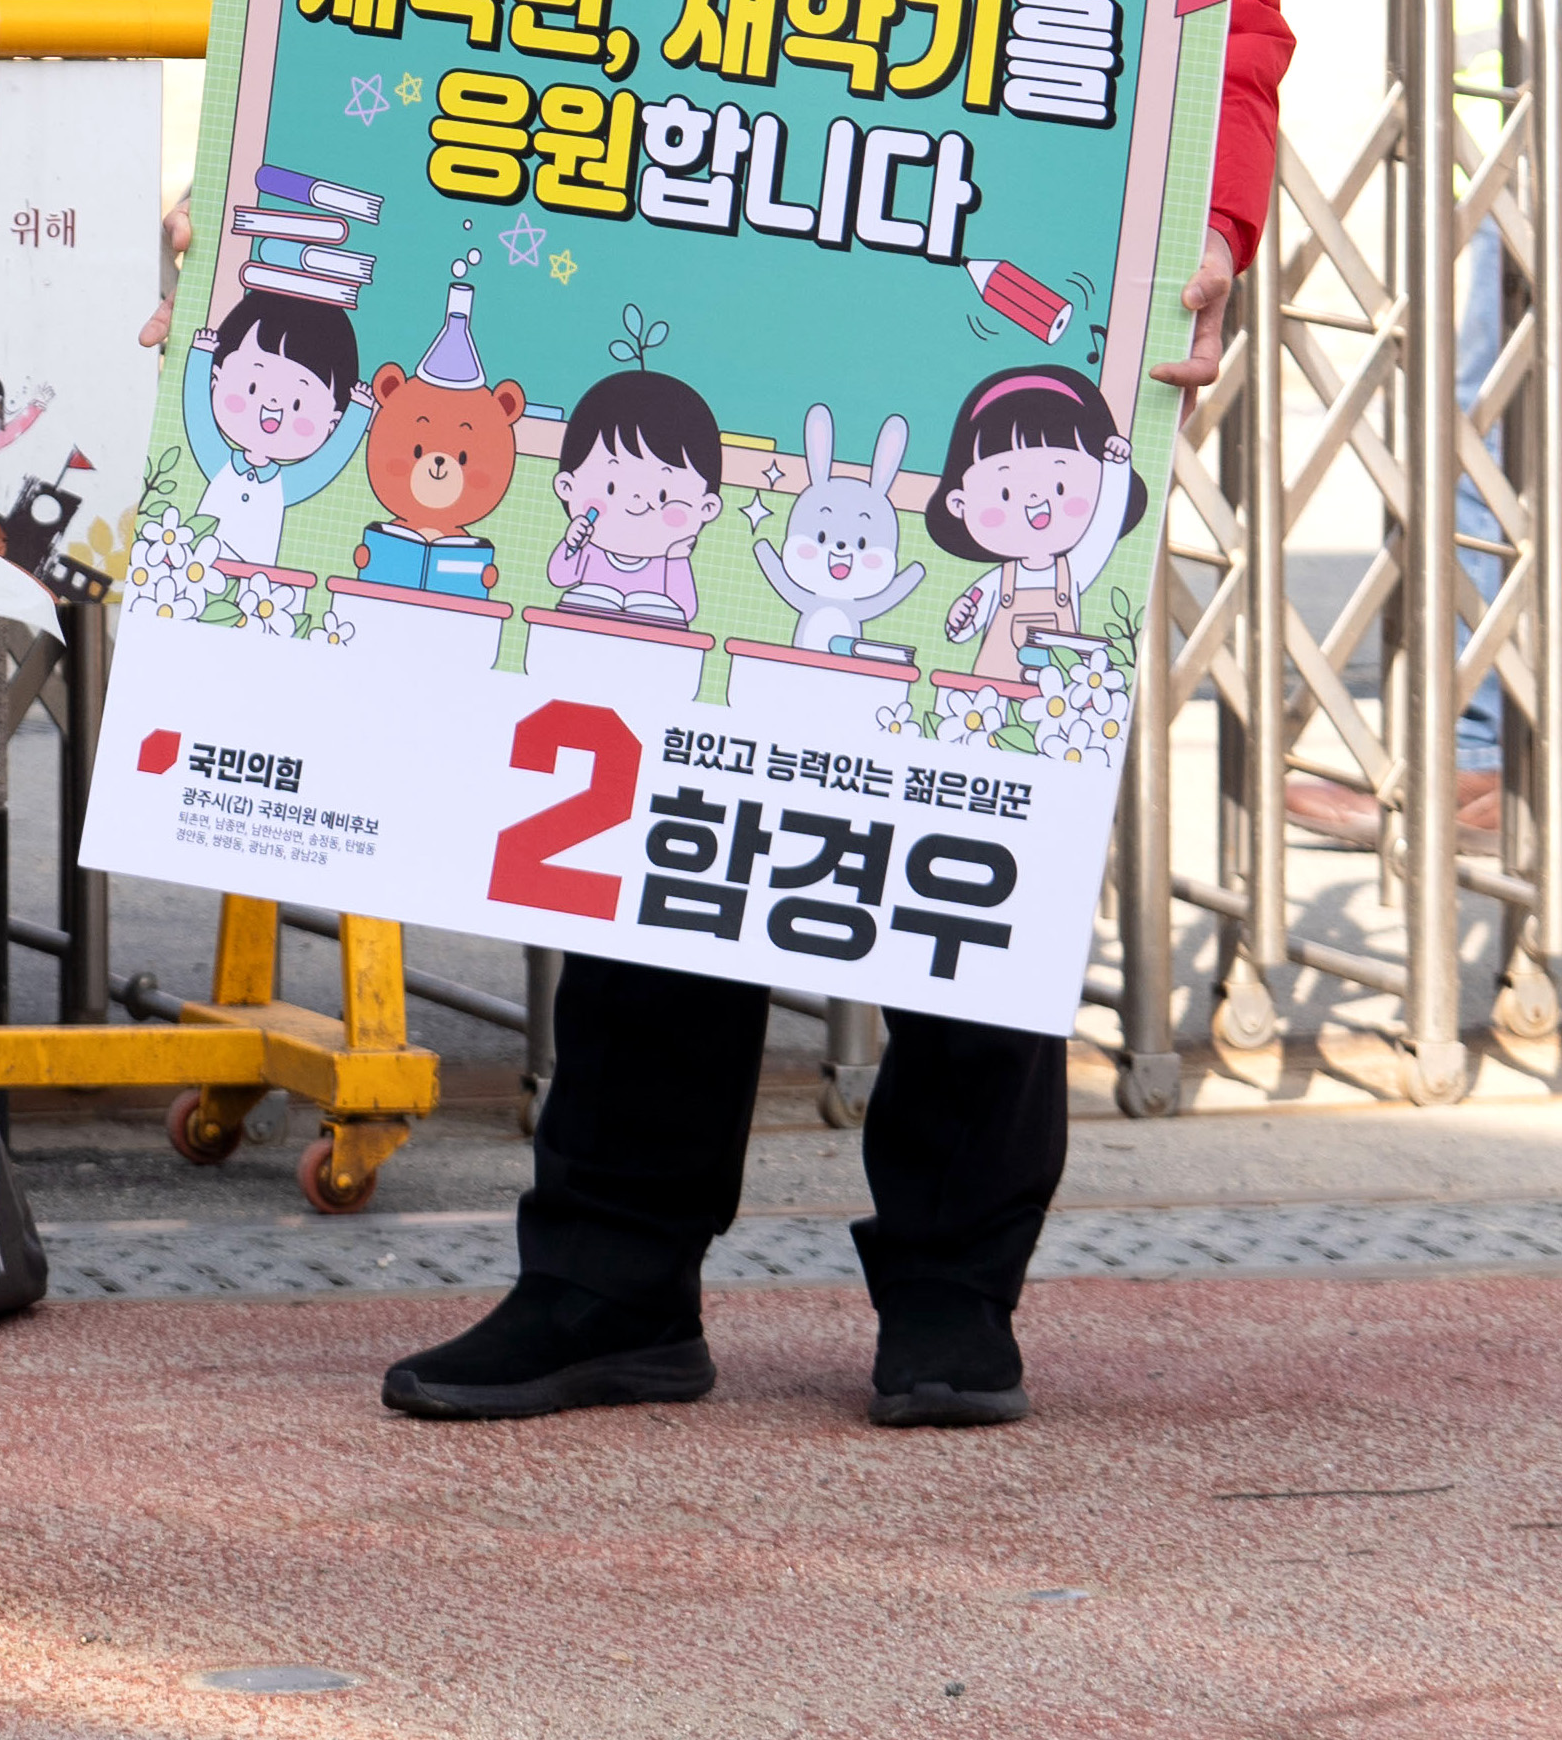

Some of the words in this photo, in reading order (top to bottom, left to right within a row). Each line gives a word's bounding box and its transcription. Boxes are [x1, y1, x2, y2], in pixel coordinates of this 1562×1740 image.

[426, 67, 982, 260] 응원합니다
[9, 206, 78, 250] 위해
[181, 786, 254, 817] 광주시(갑)
[258, 799, 317, 827] 국회의원
[320, 810, 380, 836] 예비후보
[187, 742, 304, 794] 국민의힘
[487, 698, 643, 922] 2
[660, 724, 760, 777] 힘있고
[764, 740, 896, 801] 능력있는
[902, 763, 1034, 823] 젊은일꾼
[637, 784, 1019, 983] 함경우
